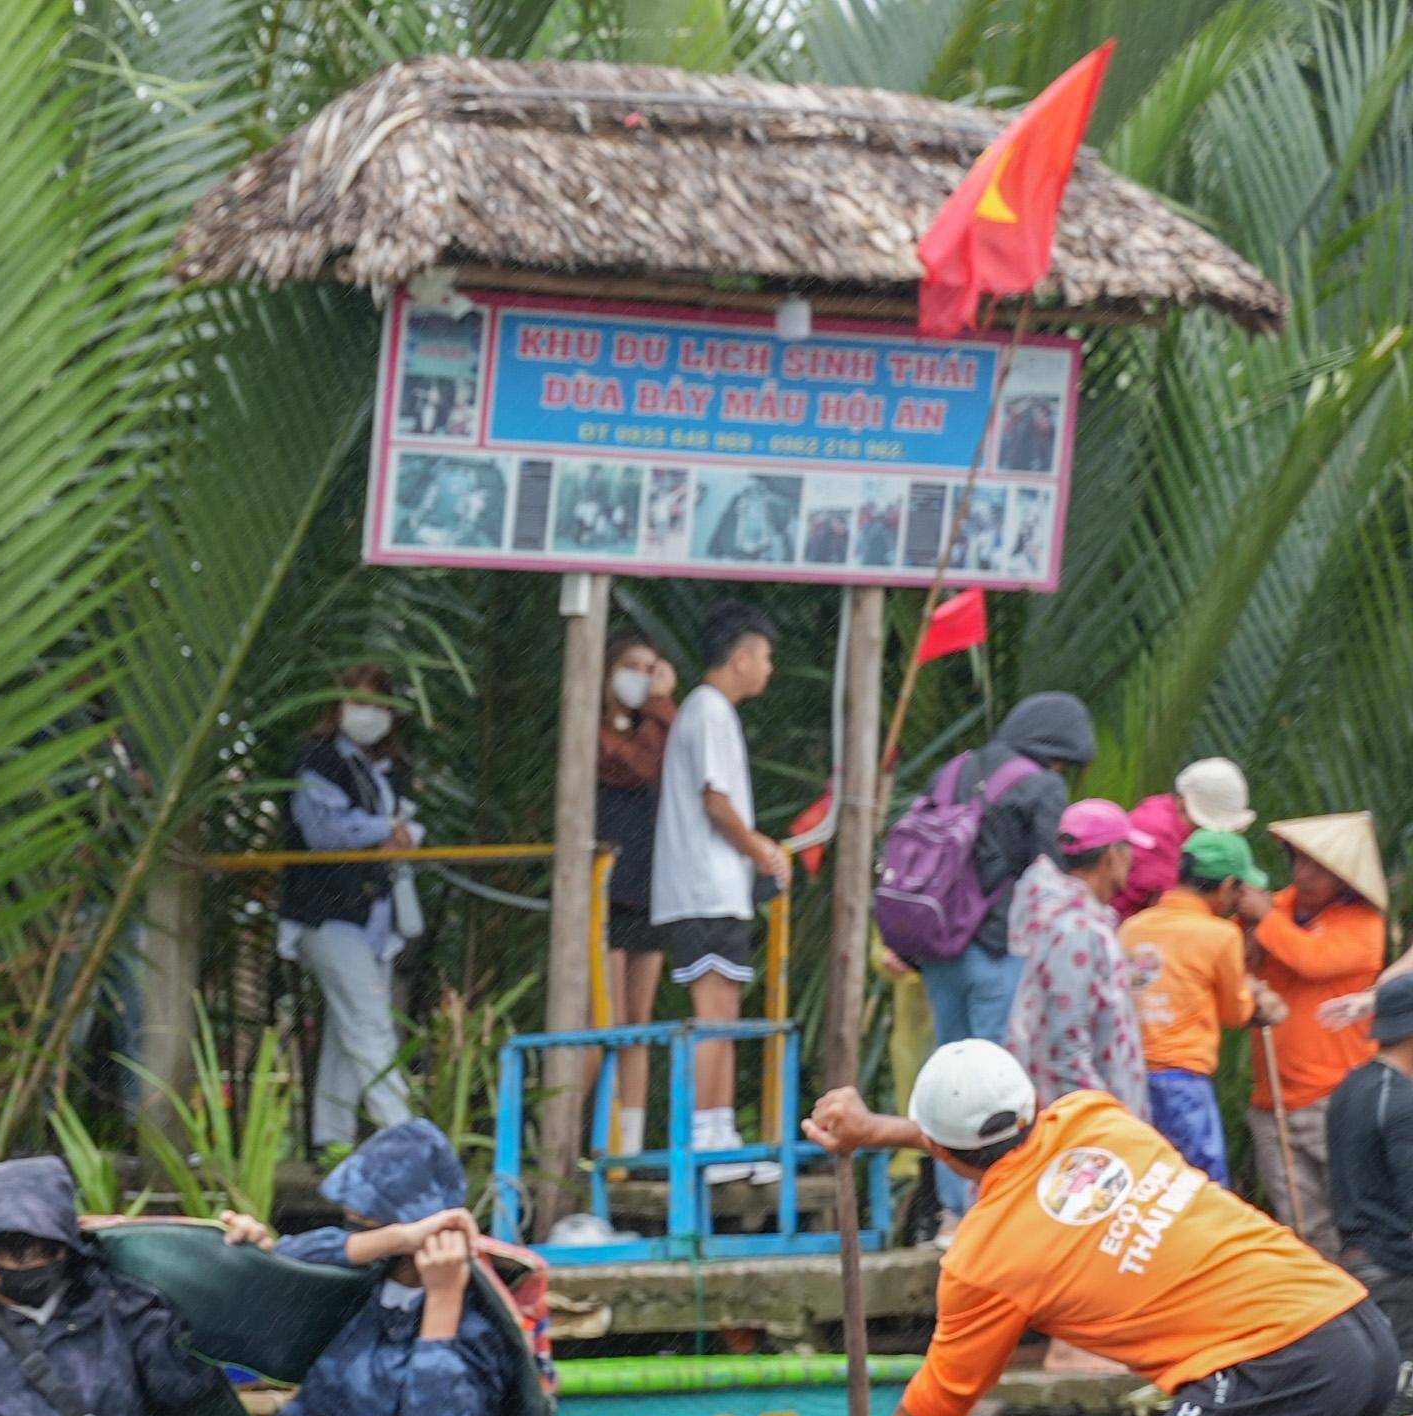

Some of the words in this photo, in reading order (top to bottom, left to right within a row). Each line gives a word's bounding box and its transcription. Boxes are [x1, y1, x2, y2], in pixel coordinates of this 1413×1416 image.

[517, 325, 601, 364] KHU
[613, 332, 669, 369] DU
[680, 337, 771, 378] LỊCH
[784, 345, 876, 384] SINH
[889, 351, 977, 391] THÁI
[817, 389, 885, 434] HỘI
[891, 397, 948, 434] AN
[1099, 1202, 1139, 1256] ECO
